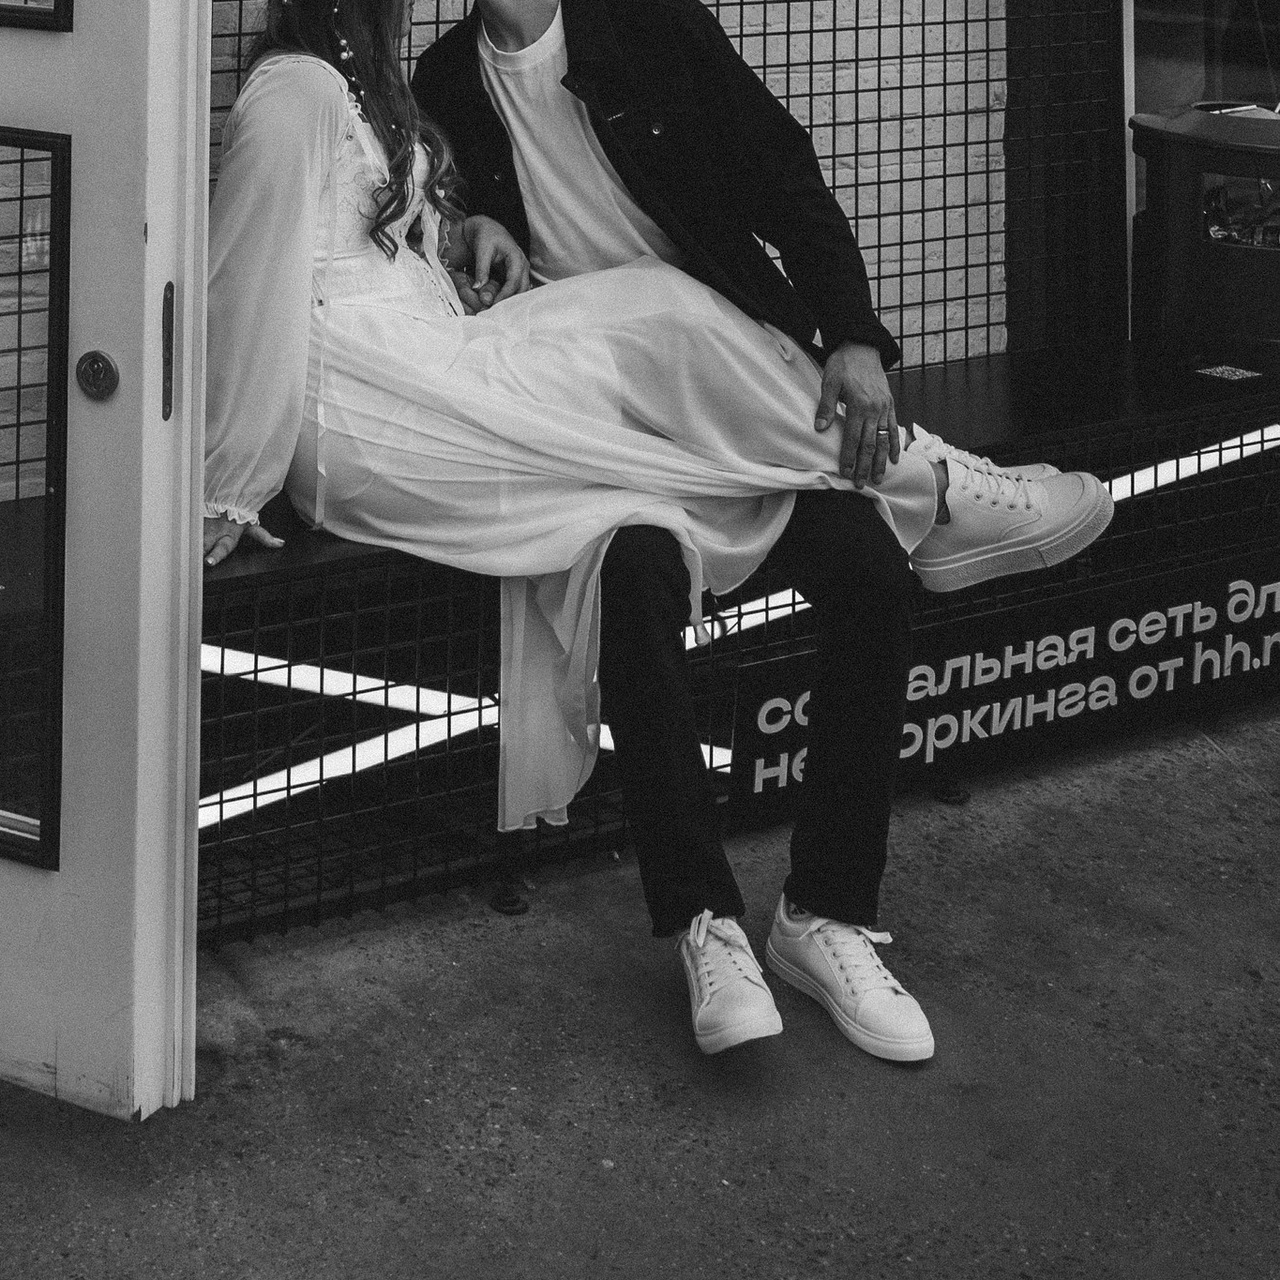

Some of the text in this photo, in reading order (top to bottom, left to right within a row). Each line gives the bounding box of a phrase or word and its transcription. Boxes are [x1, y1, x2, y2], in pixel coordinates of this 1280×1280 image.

[753, 674, 1118, 794] норкинга
[1128, 656, 1184, 699] от
[757, 625, 1096, 735] сальная
[1108, 600, 1218, 652] сеть
